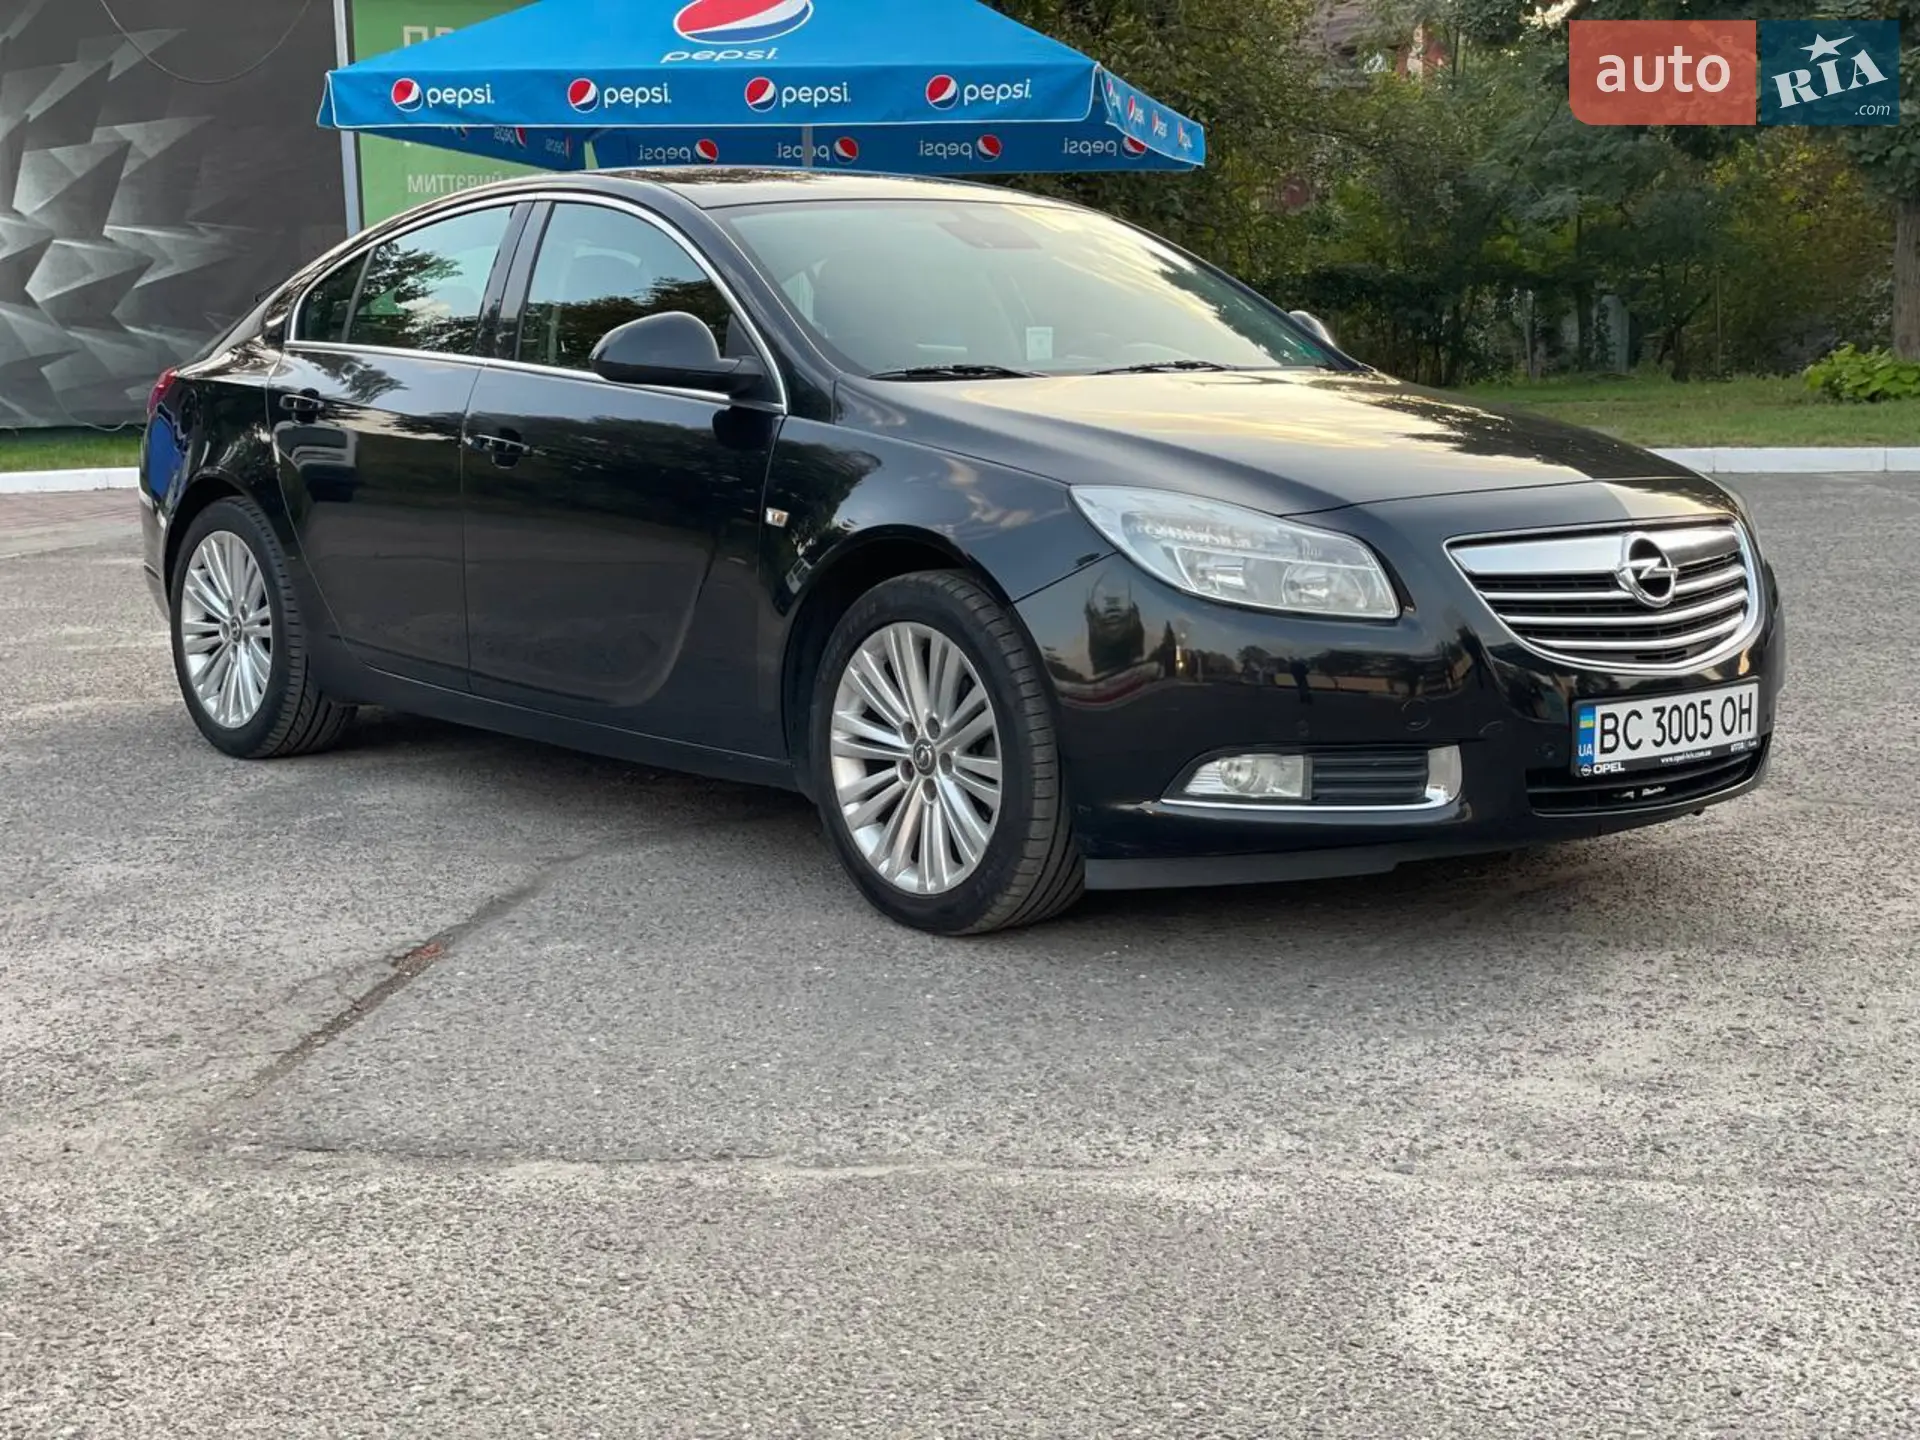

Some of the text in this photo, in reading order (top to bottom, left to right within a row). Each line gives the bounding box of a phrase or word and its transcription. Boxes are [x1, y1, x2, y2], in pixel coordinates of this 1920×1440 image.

[660, 47, 778, 63] pepsi
[426, 83, 493, 108] pepsi
[603, 82, 669, 108] pepsi
[782, 81, 849, 108] pepsi
[964, 78, 1031, 106] pepsi
[1600, 692, 1752, 756] BC 3005 OH
[1578, 743, 1593, 757] UA
[1592, 762, 1626, 775] OPEL
